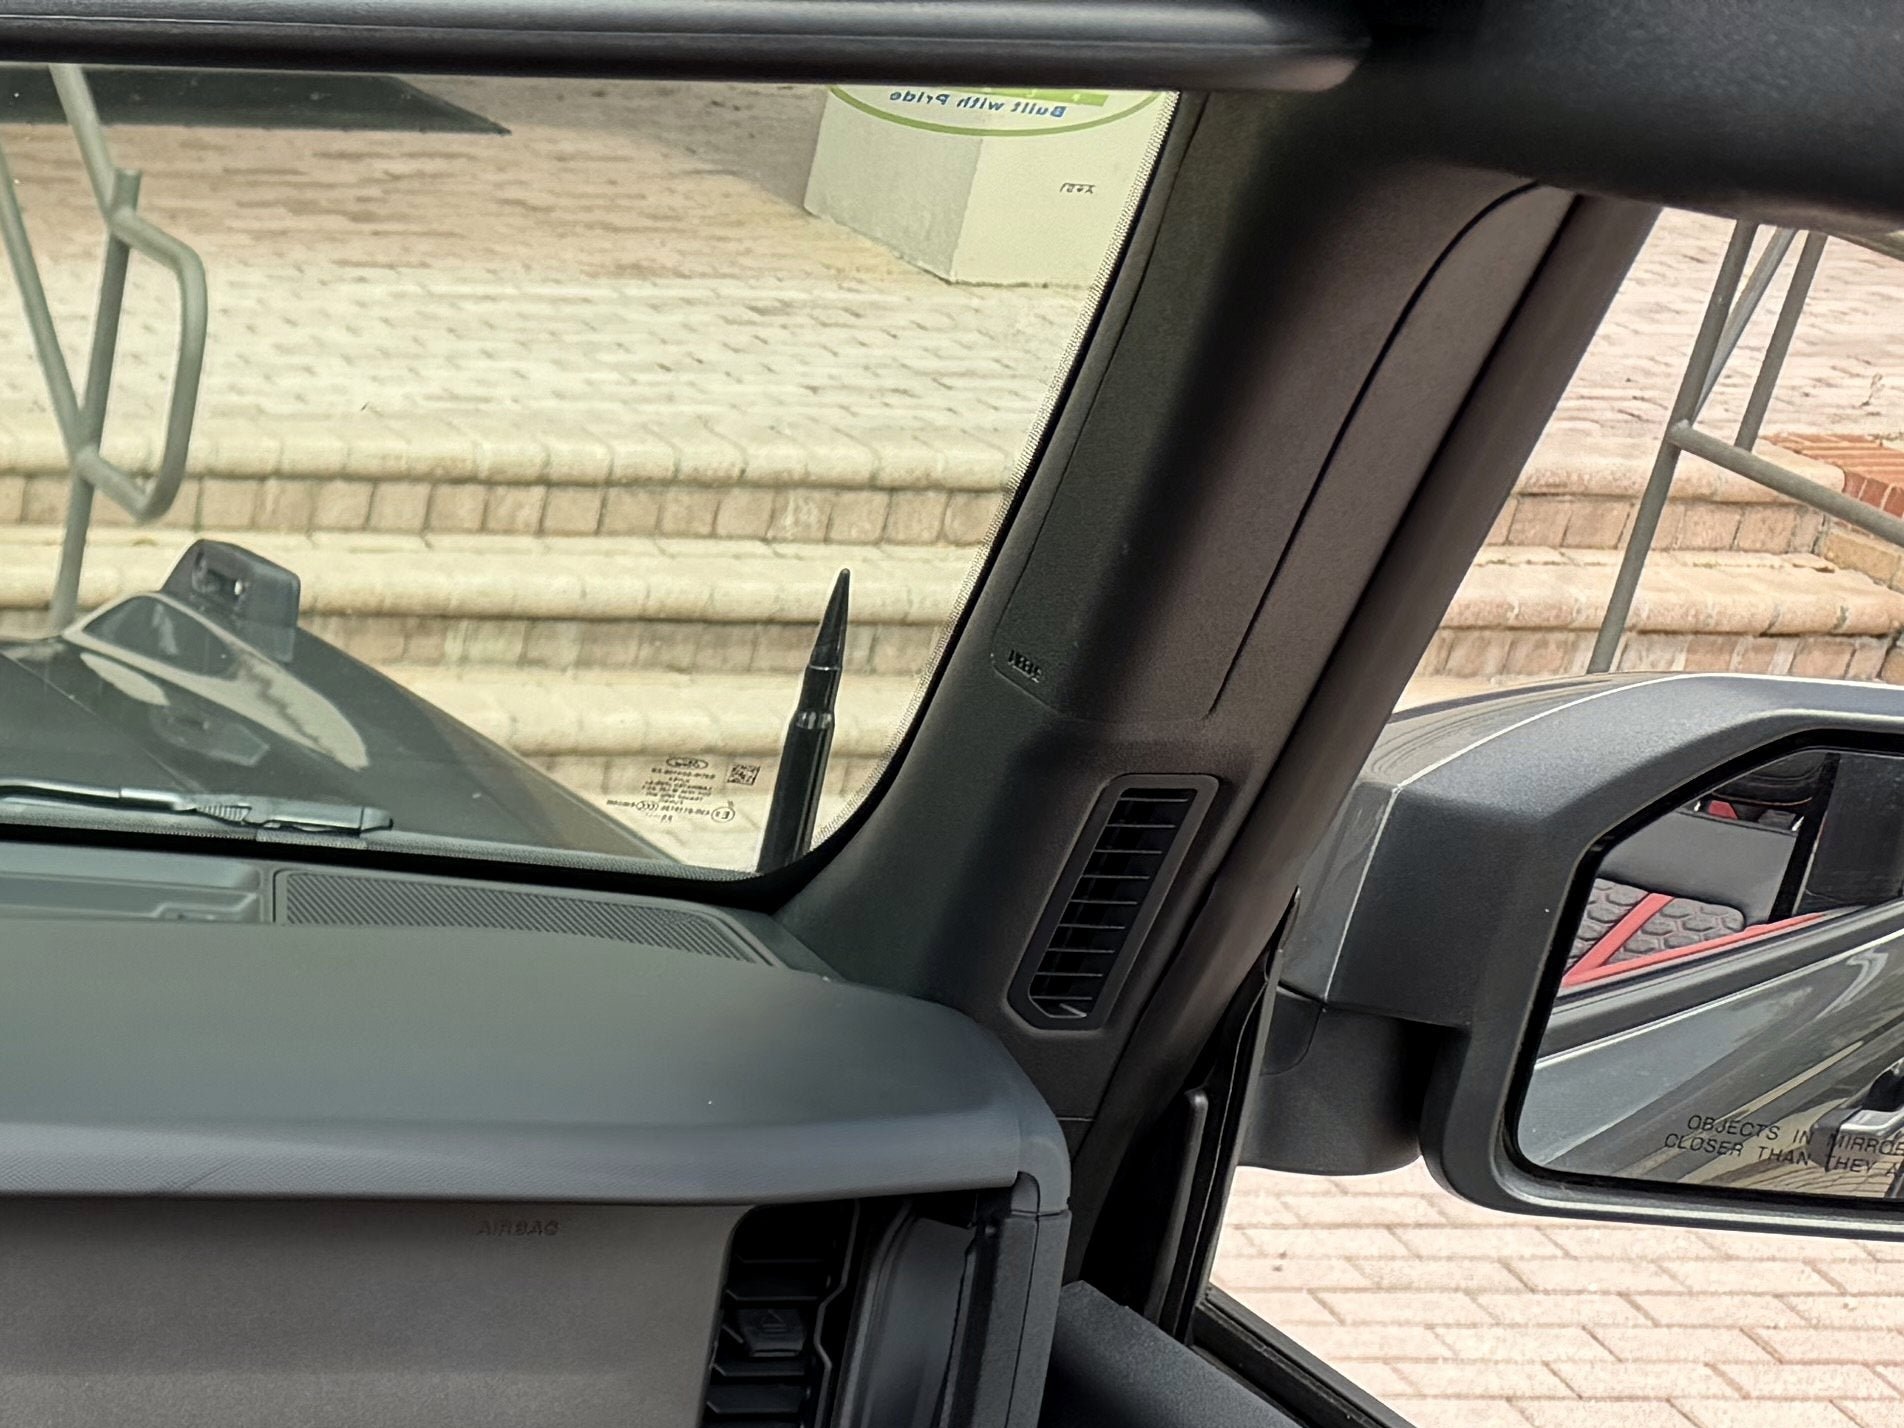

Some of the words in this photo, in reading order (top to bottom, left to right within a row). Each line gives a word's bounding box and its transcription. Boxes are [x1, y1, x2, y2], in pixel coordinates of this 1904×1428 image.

[1687, 1115, 1781, 1140] OBJECTS
[1793, 1128, 1813, 1145] IN
[1664, 1133, 1744, 1157] CLOSER
[1757, 1146, 1812, 1167] THAN
